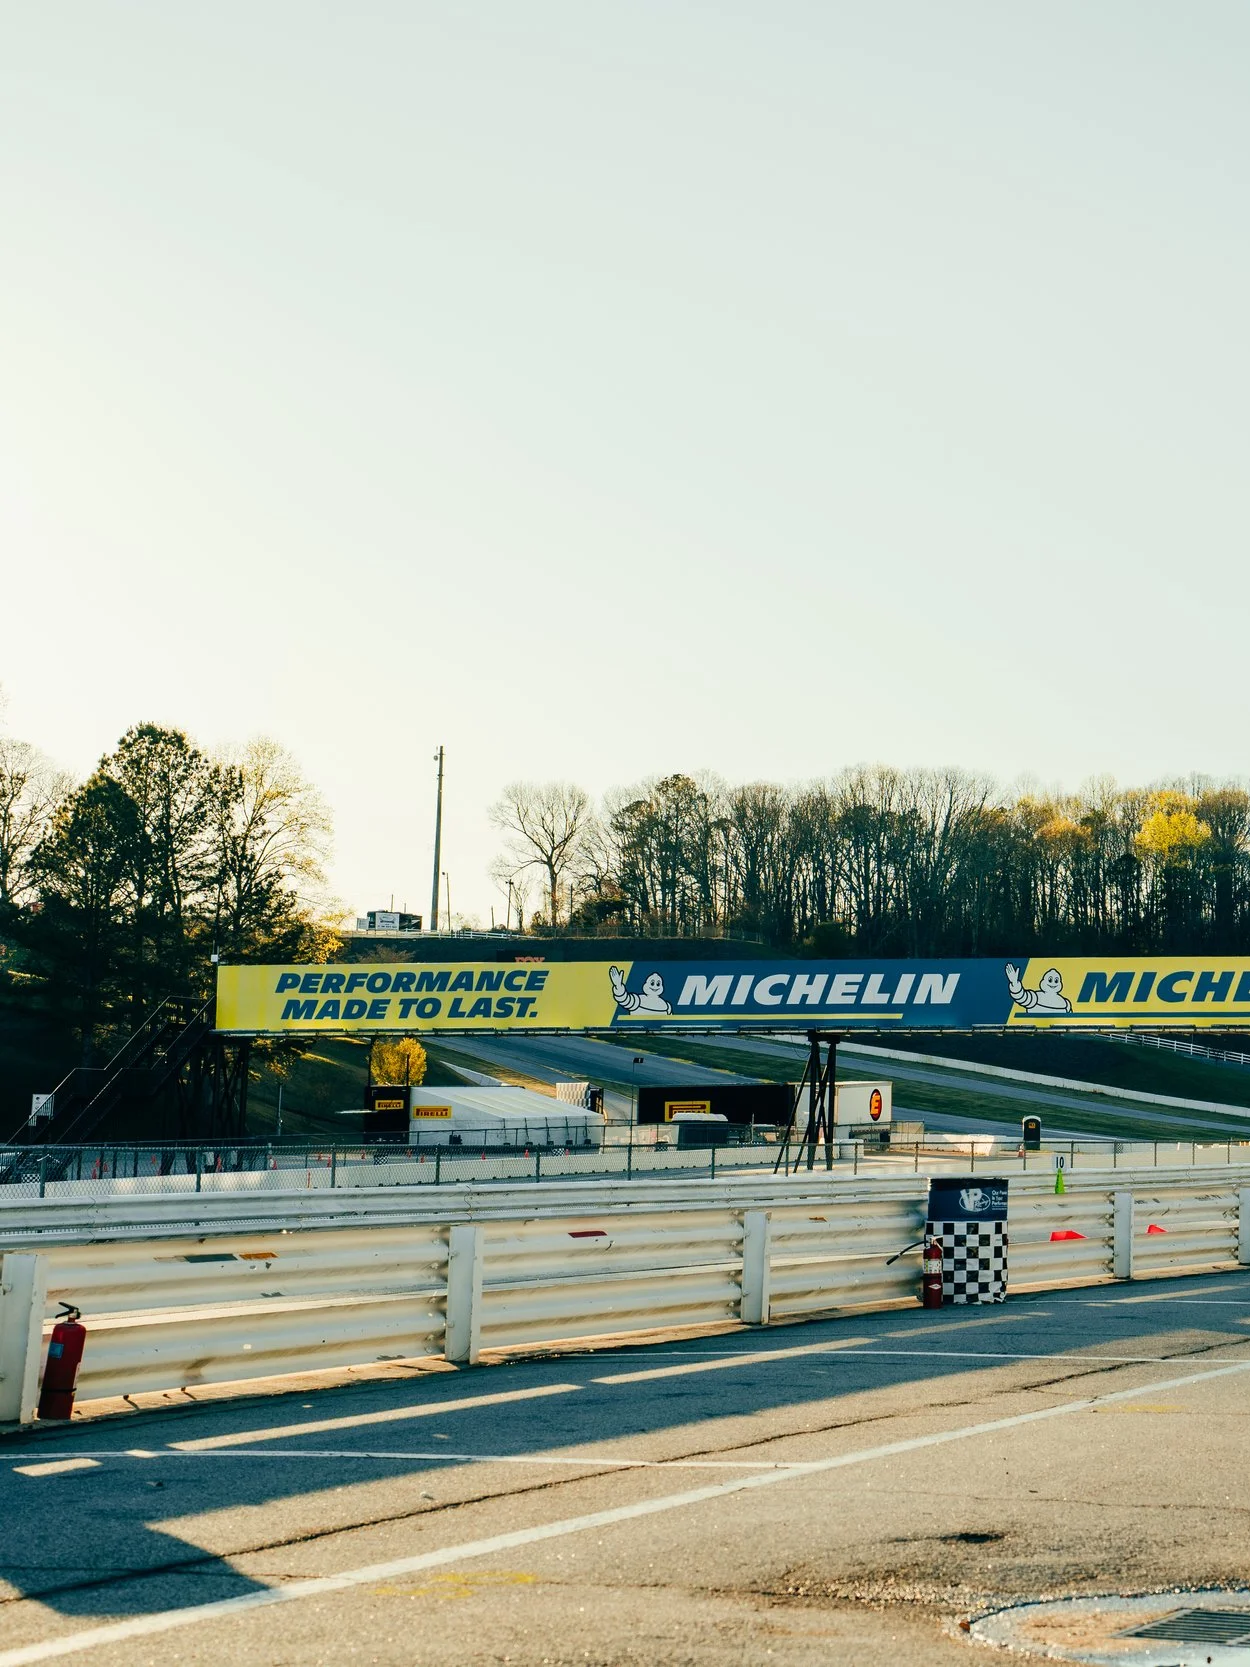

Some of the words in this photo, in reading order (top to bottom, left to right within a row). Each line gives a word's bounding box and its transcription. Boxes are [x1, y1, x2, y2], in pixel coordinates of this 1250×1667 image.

[275, 970, 549, 993] PERFORMANCE
[677, 973, 961, 1006] MICHELIN
[280, 999, 391, 1020] MADE
[398, 997, 442, 1019] TO
[447, 997, 539, 1018] LAST.
[416, 1108, 449, 1117] PIRELLI
[1056, 1156, 1065, 1169] 10
